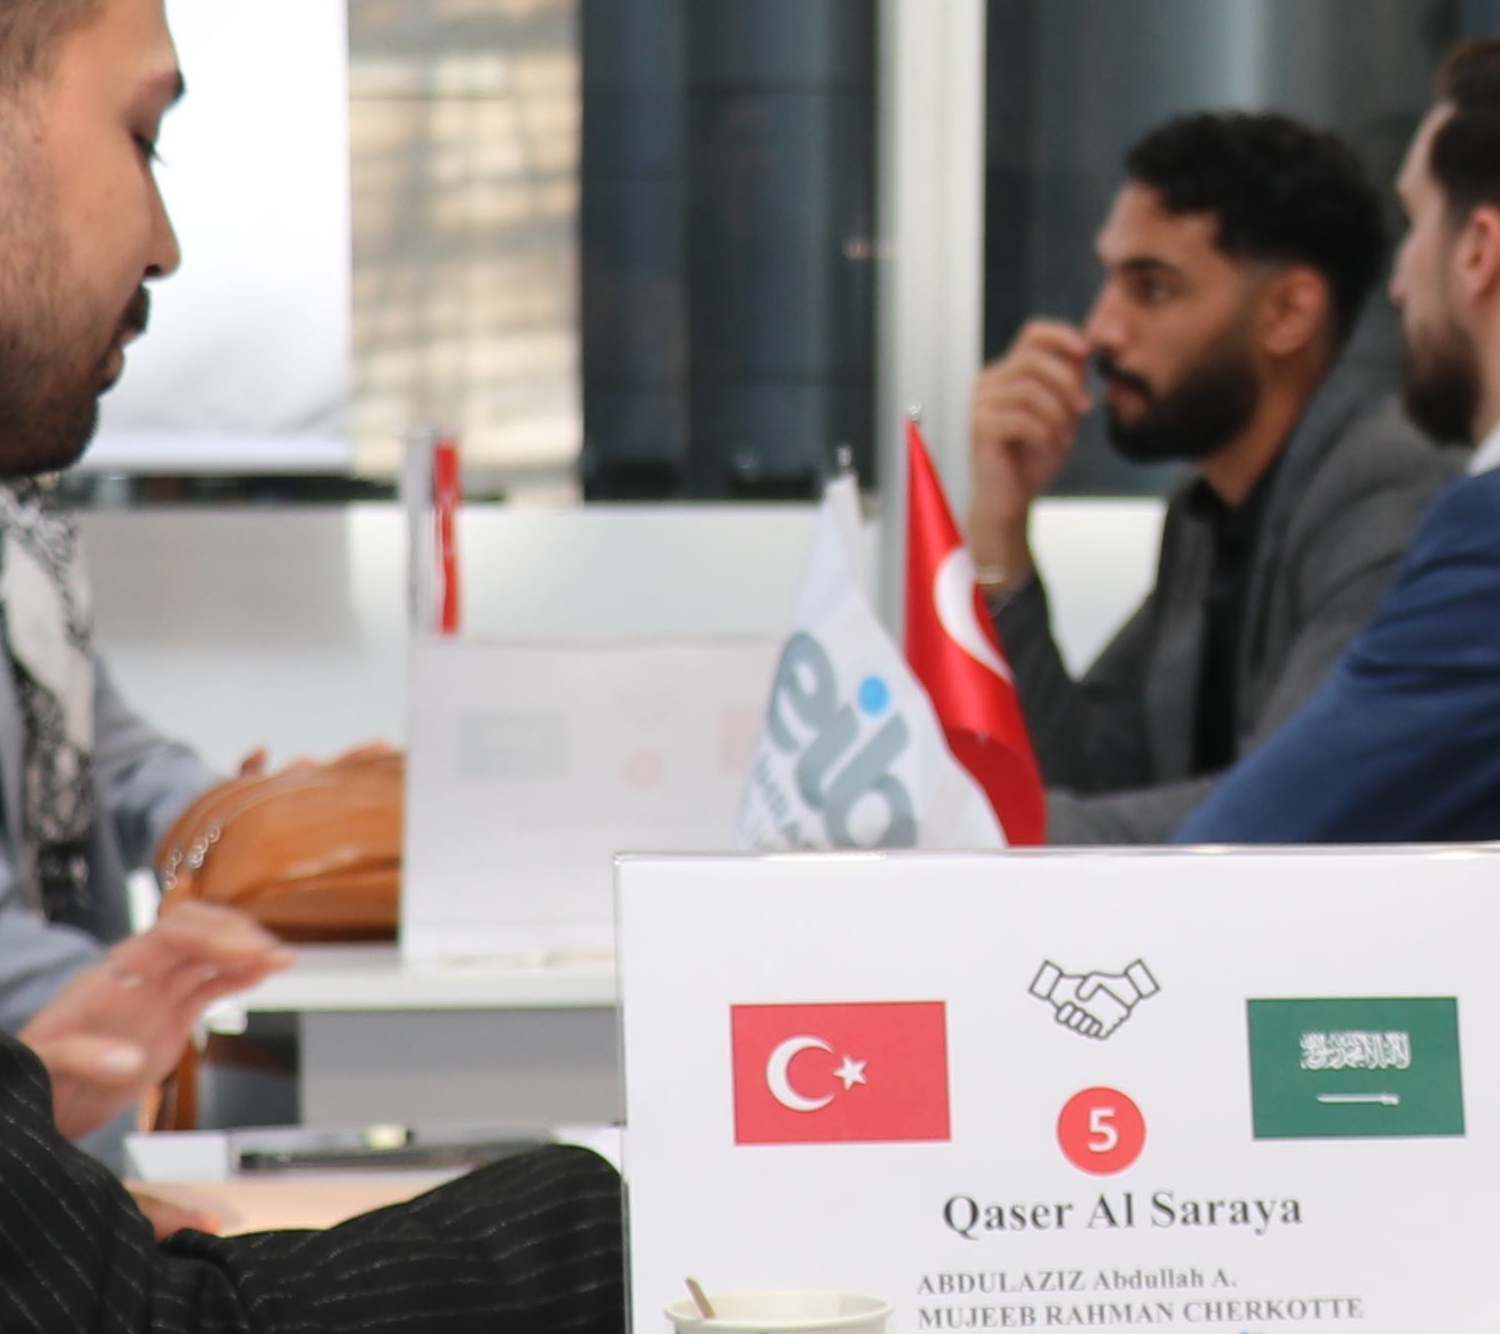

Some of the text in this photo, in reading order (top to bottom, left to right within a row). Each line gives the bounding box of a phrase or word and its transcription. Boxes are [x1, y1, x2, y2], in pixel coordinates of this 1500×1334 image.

[768, 632, 917, 847] eib
[1087, 1108, 1119, 1153] 5
[942, 1190, 1304, 1240] Qaser Al Saraya
[917, 1268, 1238, 1295] ABDULAZIZ Abdullah A.
[917, 1298, 1364, 1330] MUJEEB RAHMAN CHERKOTTE
